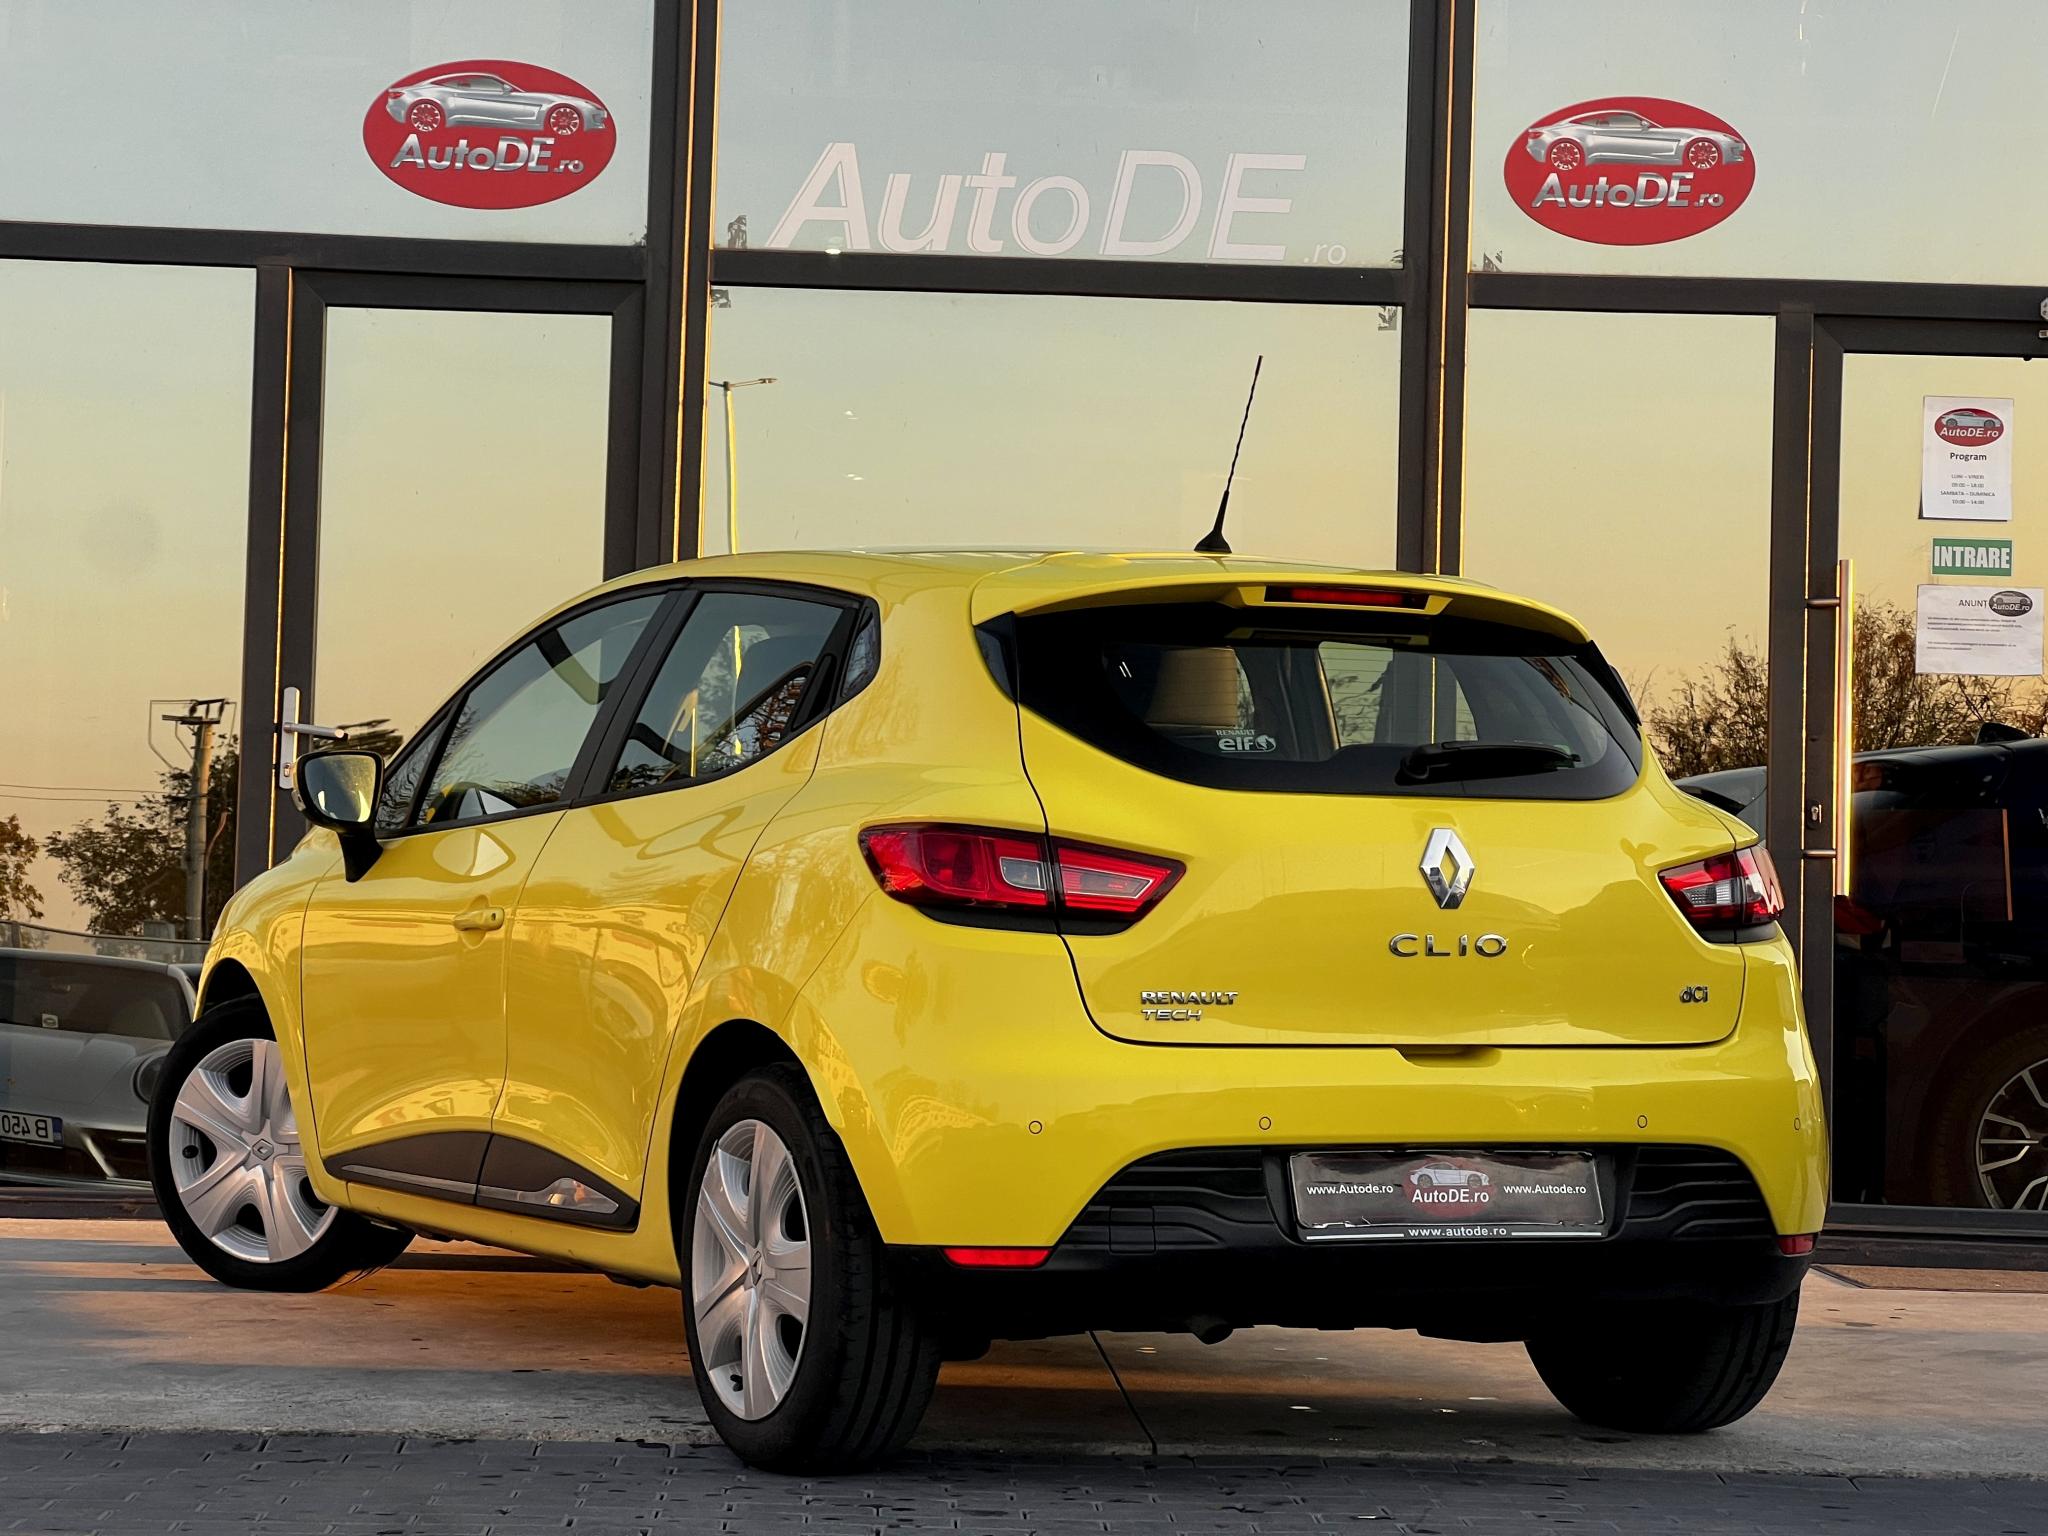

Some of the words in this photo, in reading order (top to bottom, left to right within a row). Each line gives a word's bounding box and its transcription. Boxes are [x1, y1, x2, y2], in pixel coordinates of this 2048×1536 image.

[1939, 427, 1999, 438] AutoDE.ro
[1949, 452, 1987, 462] Program
[1934, 546, 2010, 569] INTRARE
[1218, 736, 1253, 751] elf
[1389, 933, 1508, 958] CLIO
[1140, 990, 1239, 1006] RENAULT
[1679, 985, 1709, 1004] dCi
[1141, 1008, 1203, 1022] TECH
[1306, 1183, 1394, 1196] www.Autode.ro
[1411, 1188, 1490, 1205] AutoDE.ro
[1503, 1183, 1587, 1196] www.Autode.ro
[1408, 1226, 1507, 1238] www.autode.ro
